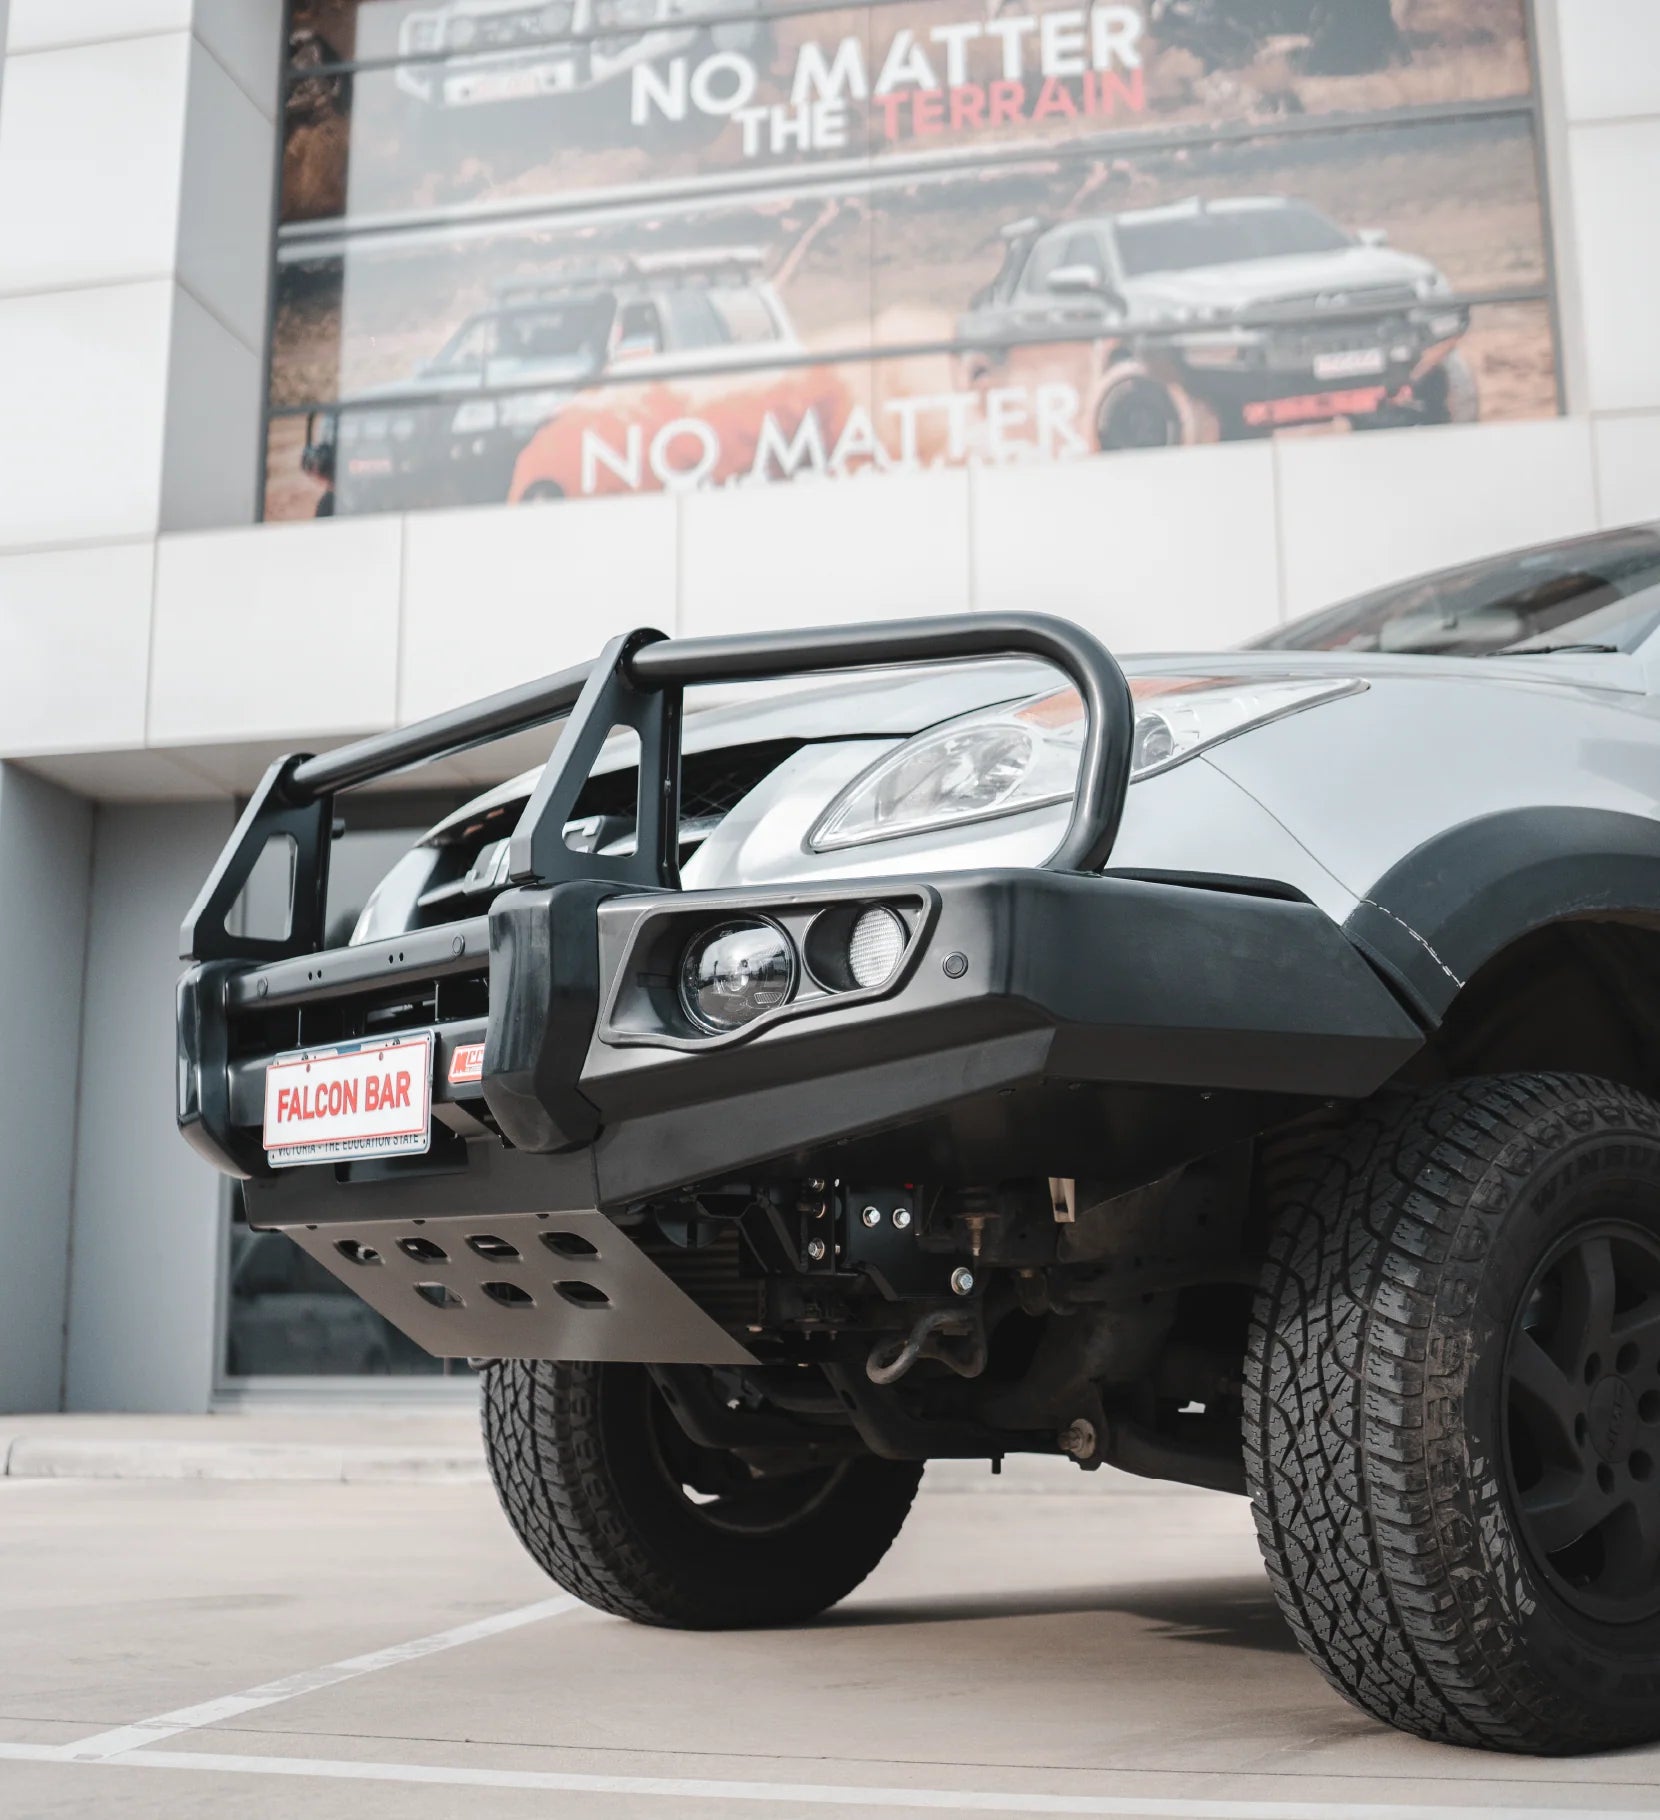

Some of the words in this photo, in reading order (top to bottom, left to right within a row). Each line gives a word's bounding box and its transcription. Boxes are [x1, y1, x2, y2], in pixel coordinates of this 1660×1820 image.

[631, 50, 756, 126] NO
[791, 3, 1145, 104] MATTER
[732, 98, 847, 157] THE
[874, 67, 1146, 140] TERRAIN
[581, 418, 719, 494] NO
[749, 383, 1091, 482] MATTER
[277, 1077, 358, 1123] FALCON
[365, 1071, 411, 1112] BAR
[324, 1141, 340, 1153] THE
[393, 1134, 419, 1145] STATE
